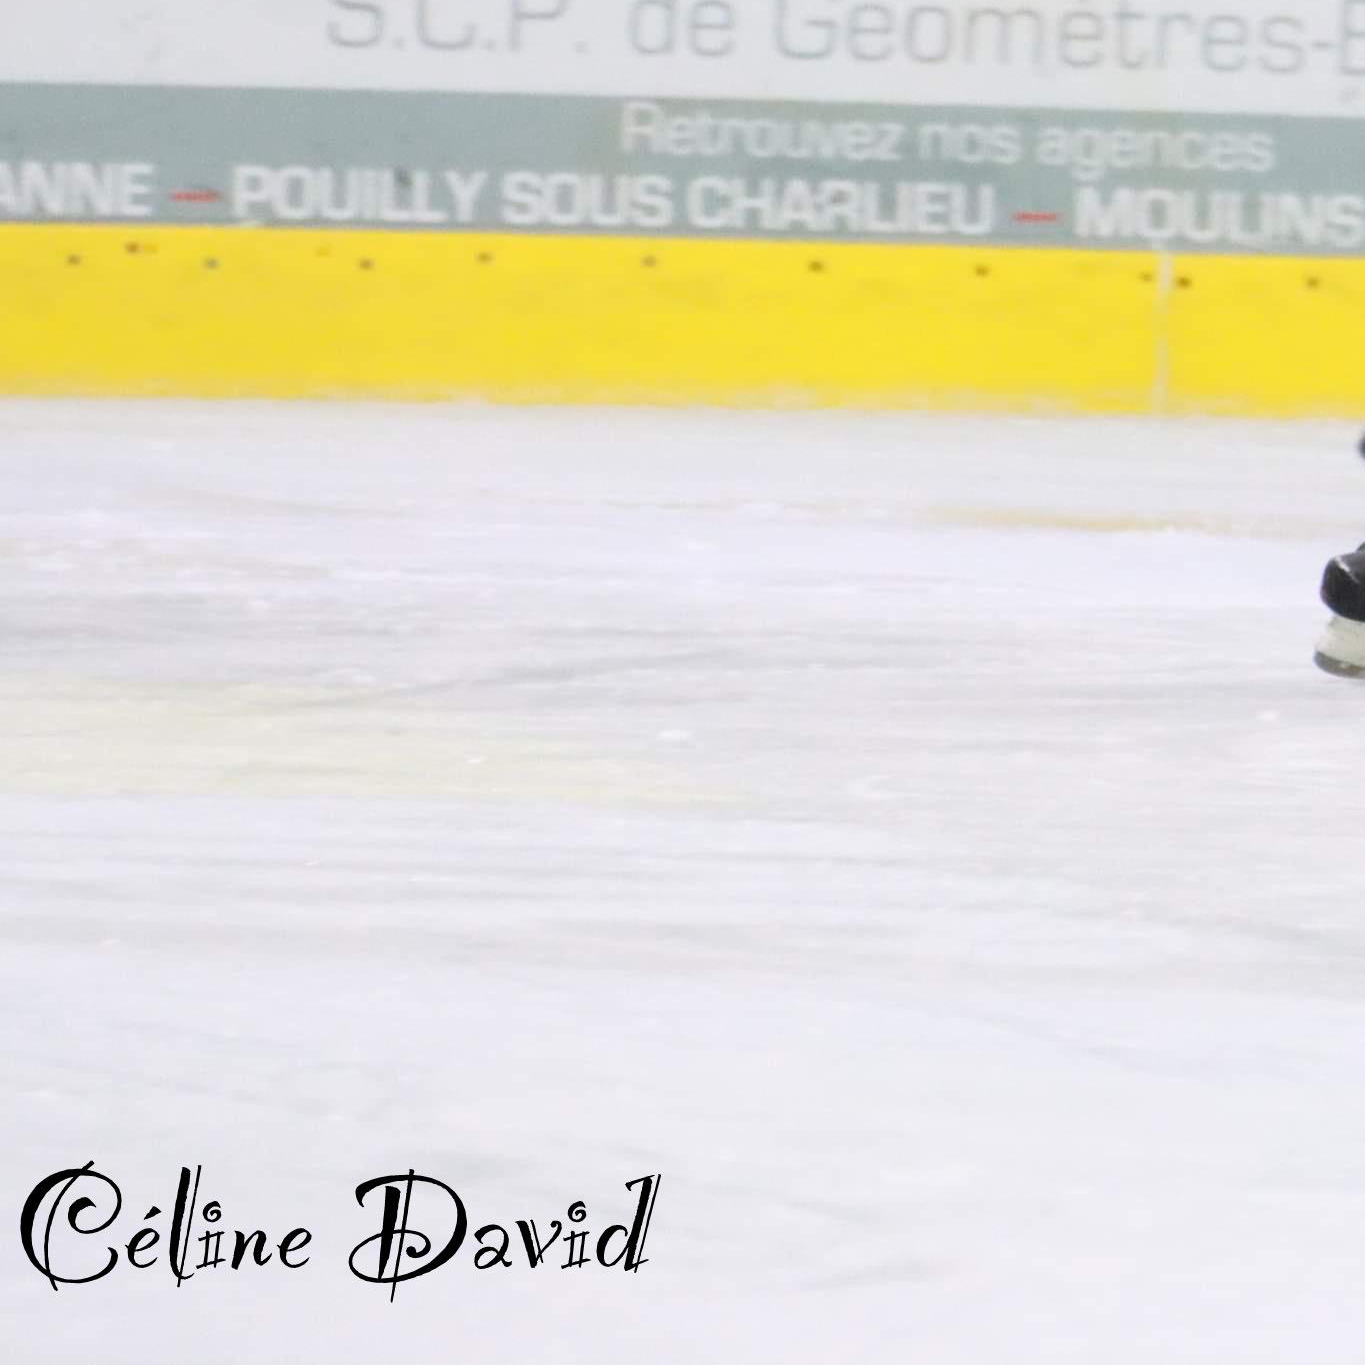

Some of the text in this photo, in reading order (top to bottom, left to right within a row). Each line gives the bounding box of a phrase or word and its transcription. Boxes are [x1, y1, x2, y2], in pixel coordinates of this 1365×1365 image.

[620, 101, 1276, 180] Retrouvez nos agences
[0, 162, 155, 218] ANNE
[230, 163, 488, 223] POUILLY
[501, 172, 675, 227] SOUS
[687, 175, 994, 236] CHARLIEU
